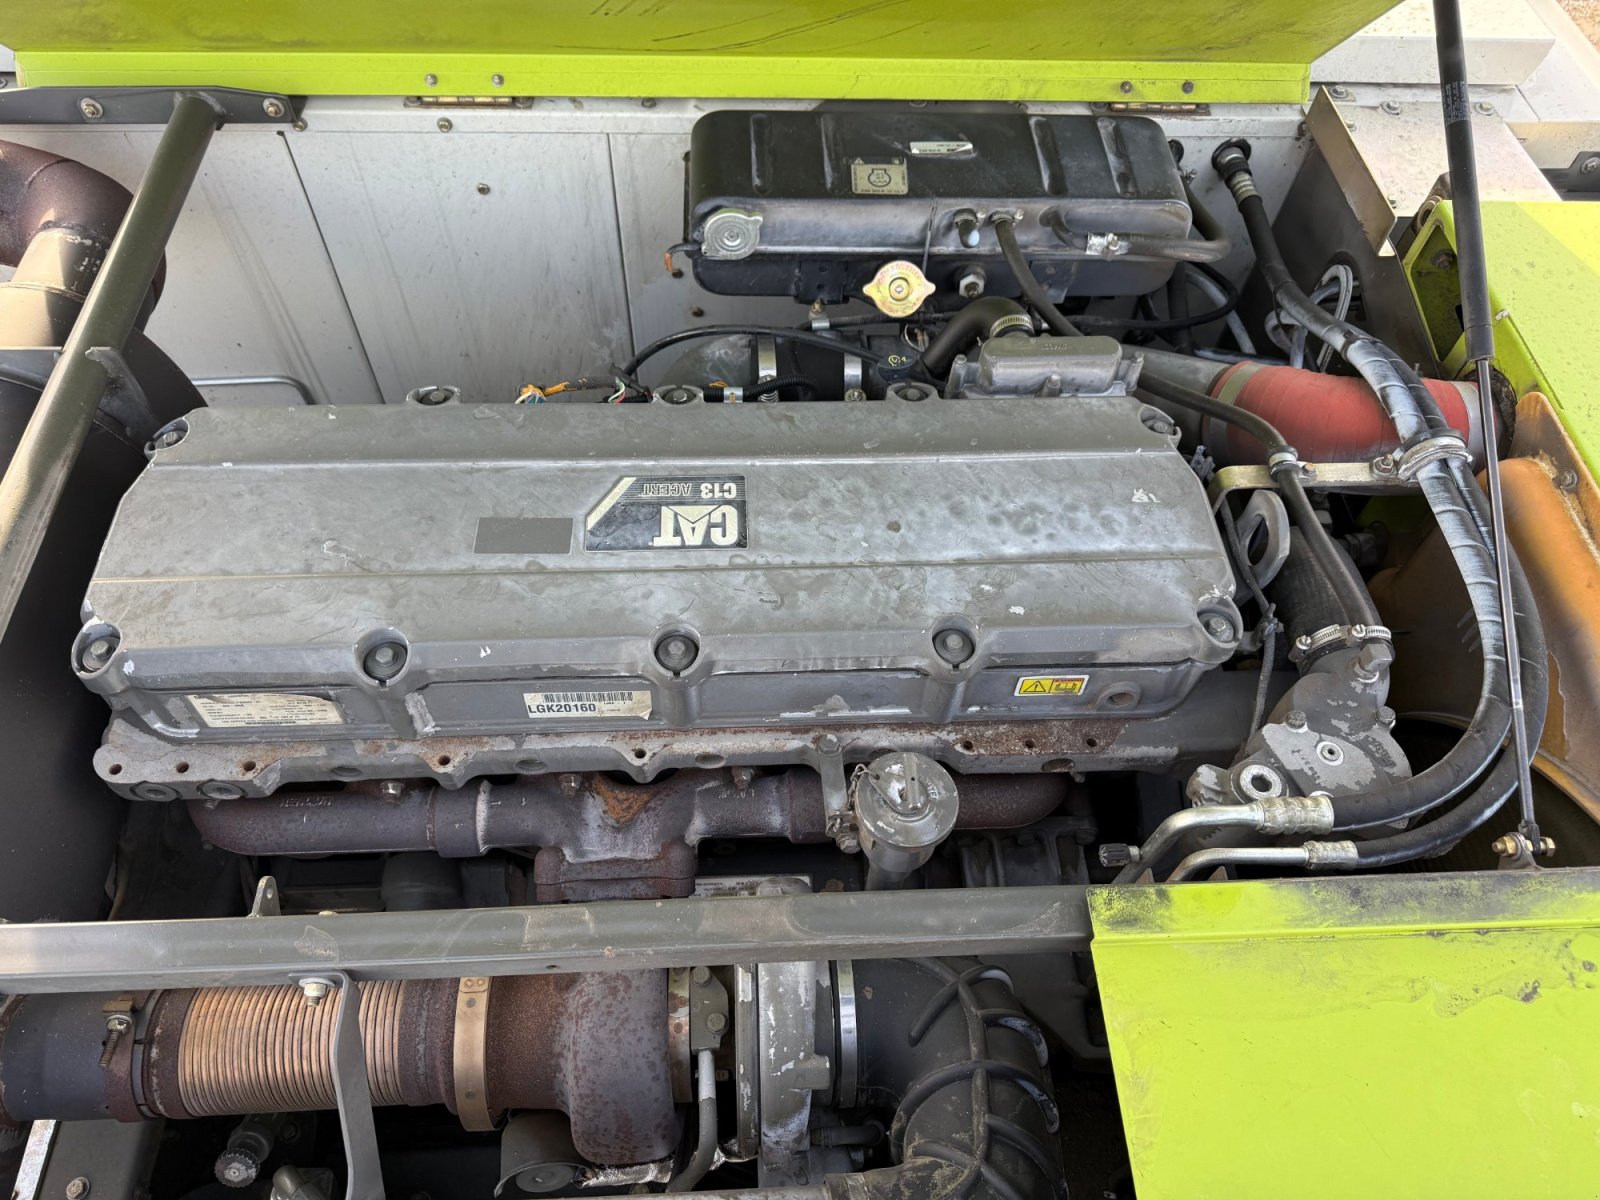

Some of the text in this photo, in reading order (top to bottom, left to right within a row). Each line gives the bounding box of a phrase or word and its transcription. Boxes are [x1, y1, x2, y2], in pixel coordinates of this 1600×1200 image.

[643, 482, 737, 499] C13 ACERT
[653, 504, 738, 547] CAT
[527, 703, 597, 714] LGK20160
